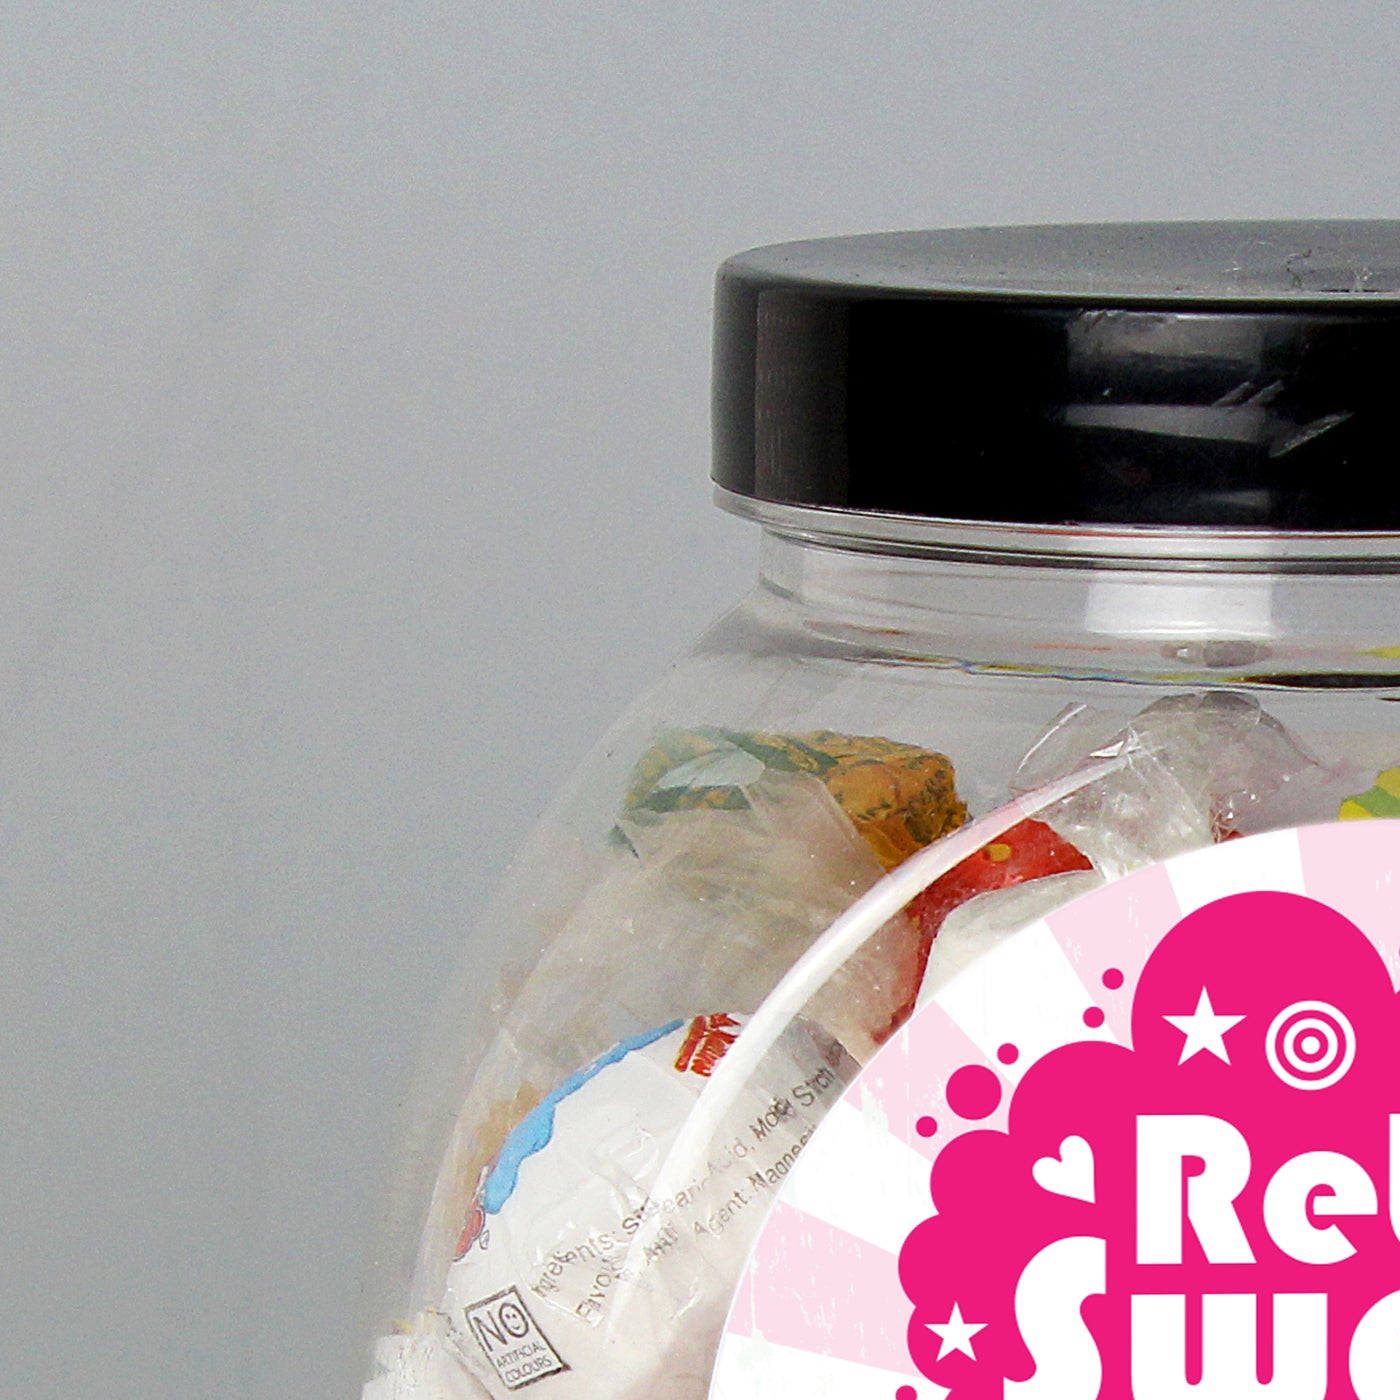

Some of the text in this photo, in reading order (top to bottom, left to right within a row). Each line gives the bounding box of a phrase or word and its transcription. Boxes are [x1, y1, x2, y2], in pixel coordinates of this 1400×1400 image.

[472, 1301, 529, 1353] NO
[496, 1340, 548, 1369] ARTIFICIAL
[504, 1354, 553, 1383] COLOURS
